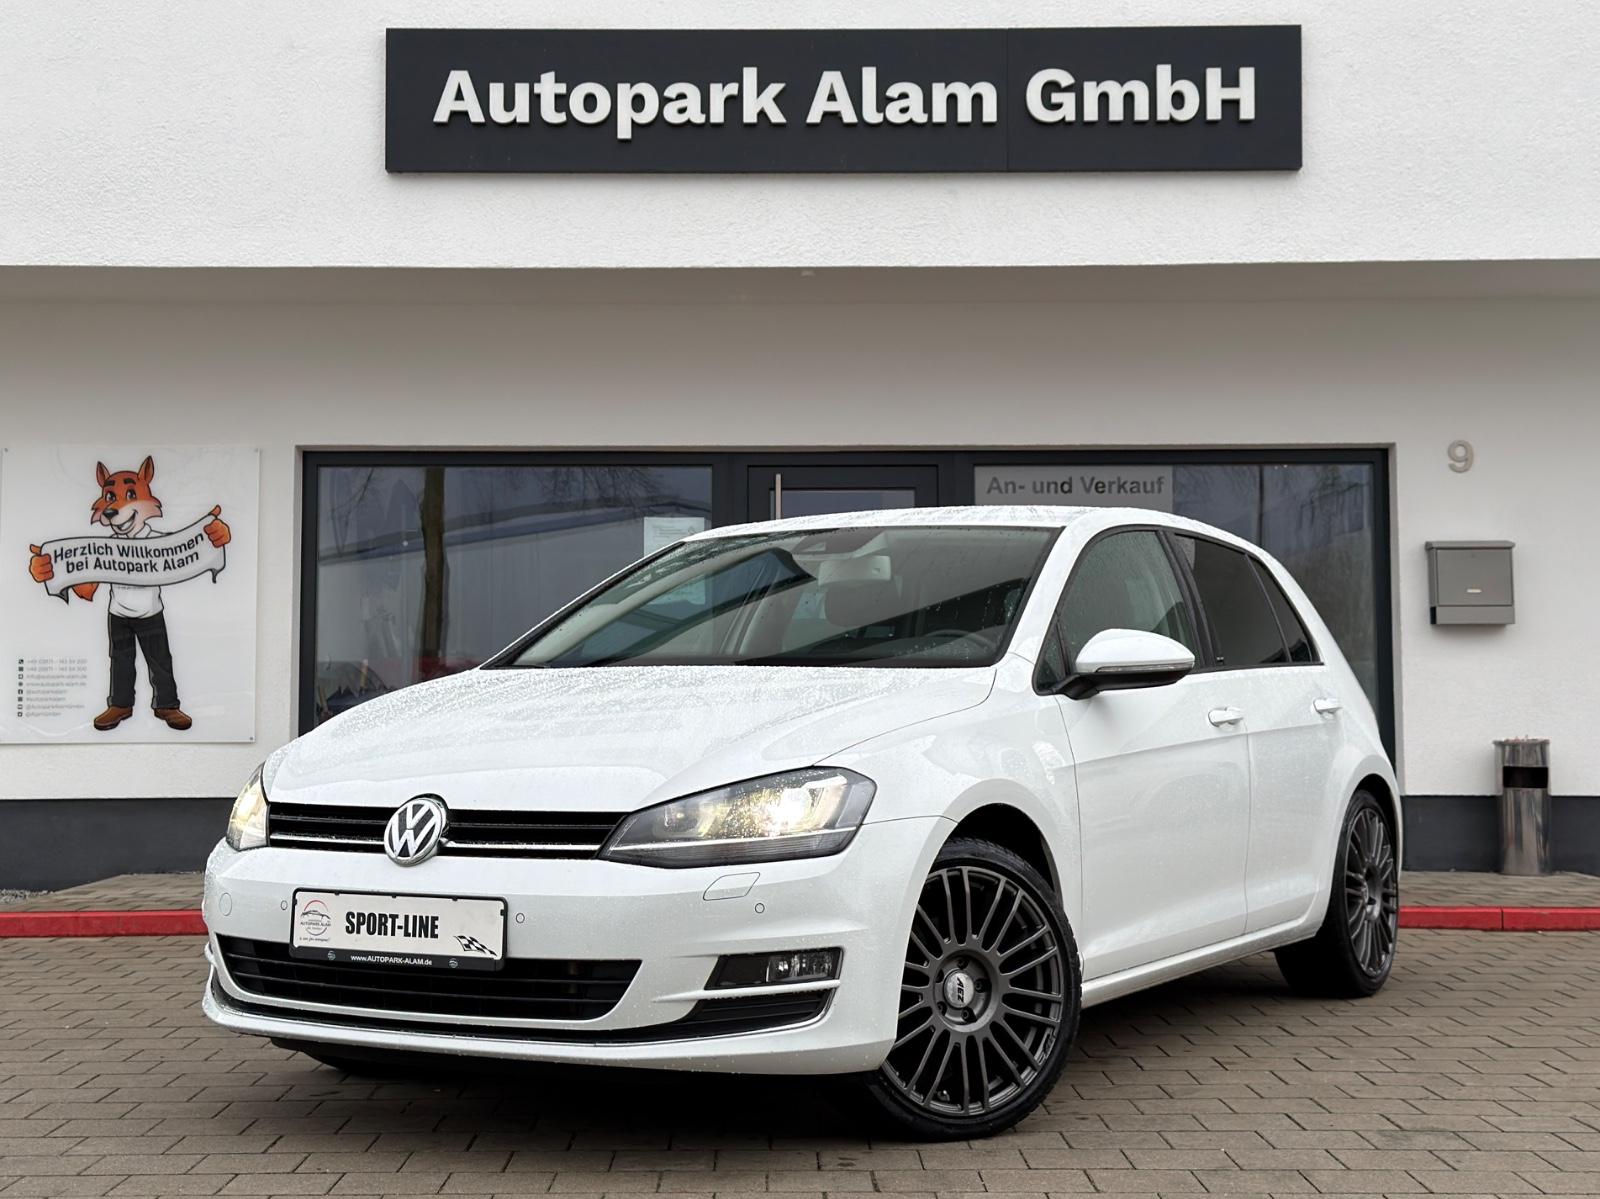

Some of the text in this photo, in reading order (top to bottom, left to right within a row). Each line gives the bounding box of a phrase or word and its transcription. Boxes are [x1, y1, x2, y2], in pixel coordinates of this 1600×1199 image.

[433, 64, 1255, 139] Autopark Alam GmbH
[1447, 440, 1475, 473] 9
[986, 476, 1165, 494] An- und Verkauf
[53, 533, 205, 563] Herzlich Willkommen
[66, 551, 200, 575] bei Autopark Alam
[345, 911, 439, 939] SPORT-LINE
[350, 955, 433, 966] www.AUTOPARK-ALAM.de
